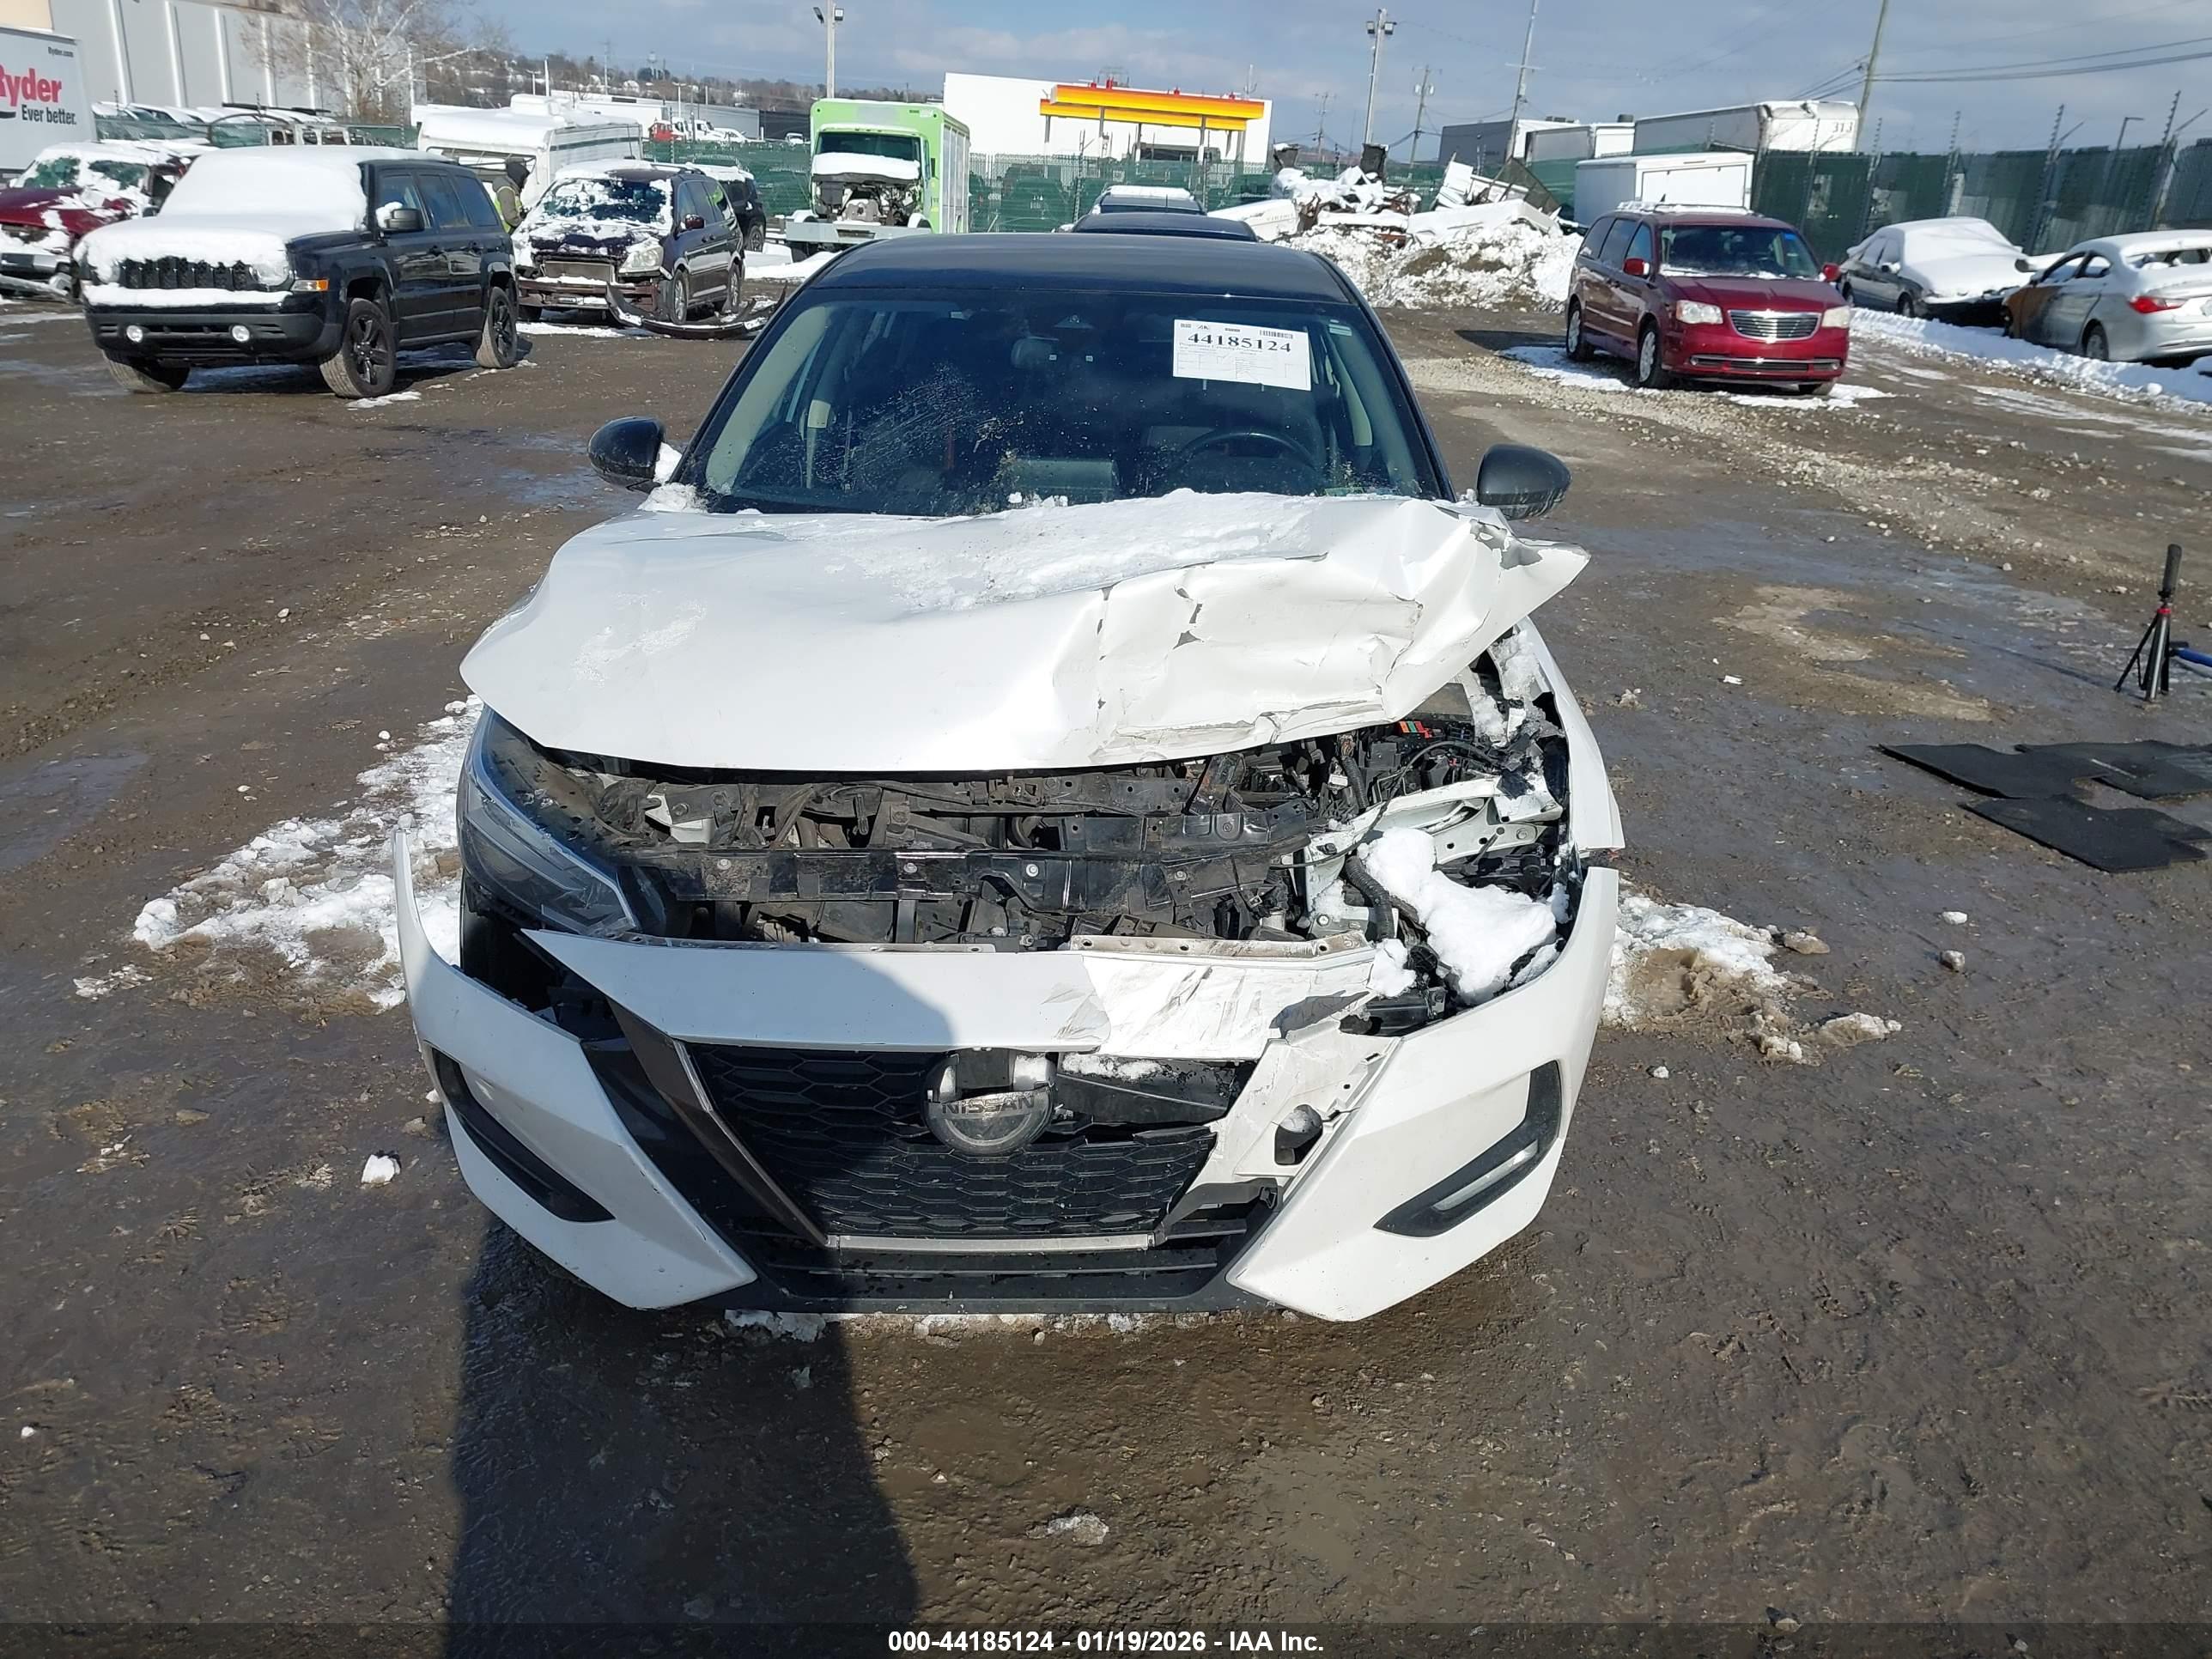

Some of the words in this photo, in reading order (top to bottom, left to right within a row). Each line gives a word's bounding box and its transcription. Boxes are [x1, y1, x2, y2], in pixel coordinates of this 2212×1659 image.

[21, 104, 44, 122] Ever
[46, 106, 76, 125] better.
[1188, 332, 1291, 353] 44185124
[942, 1095, 1035, 1115] NISSAN
